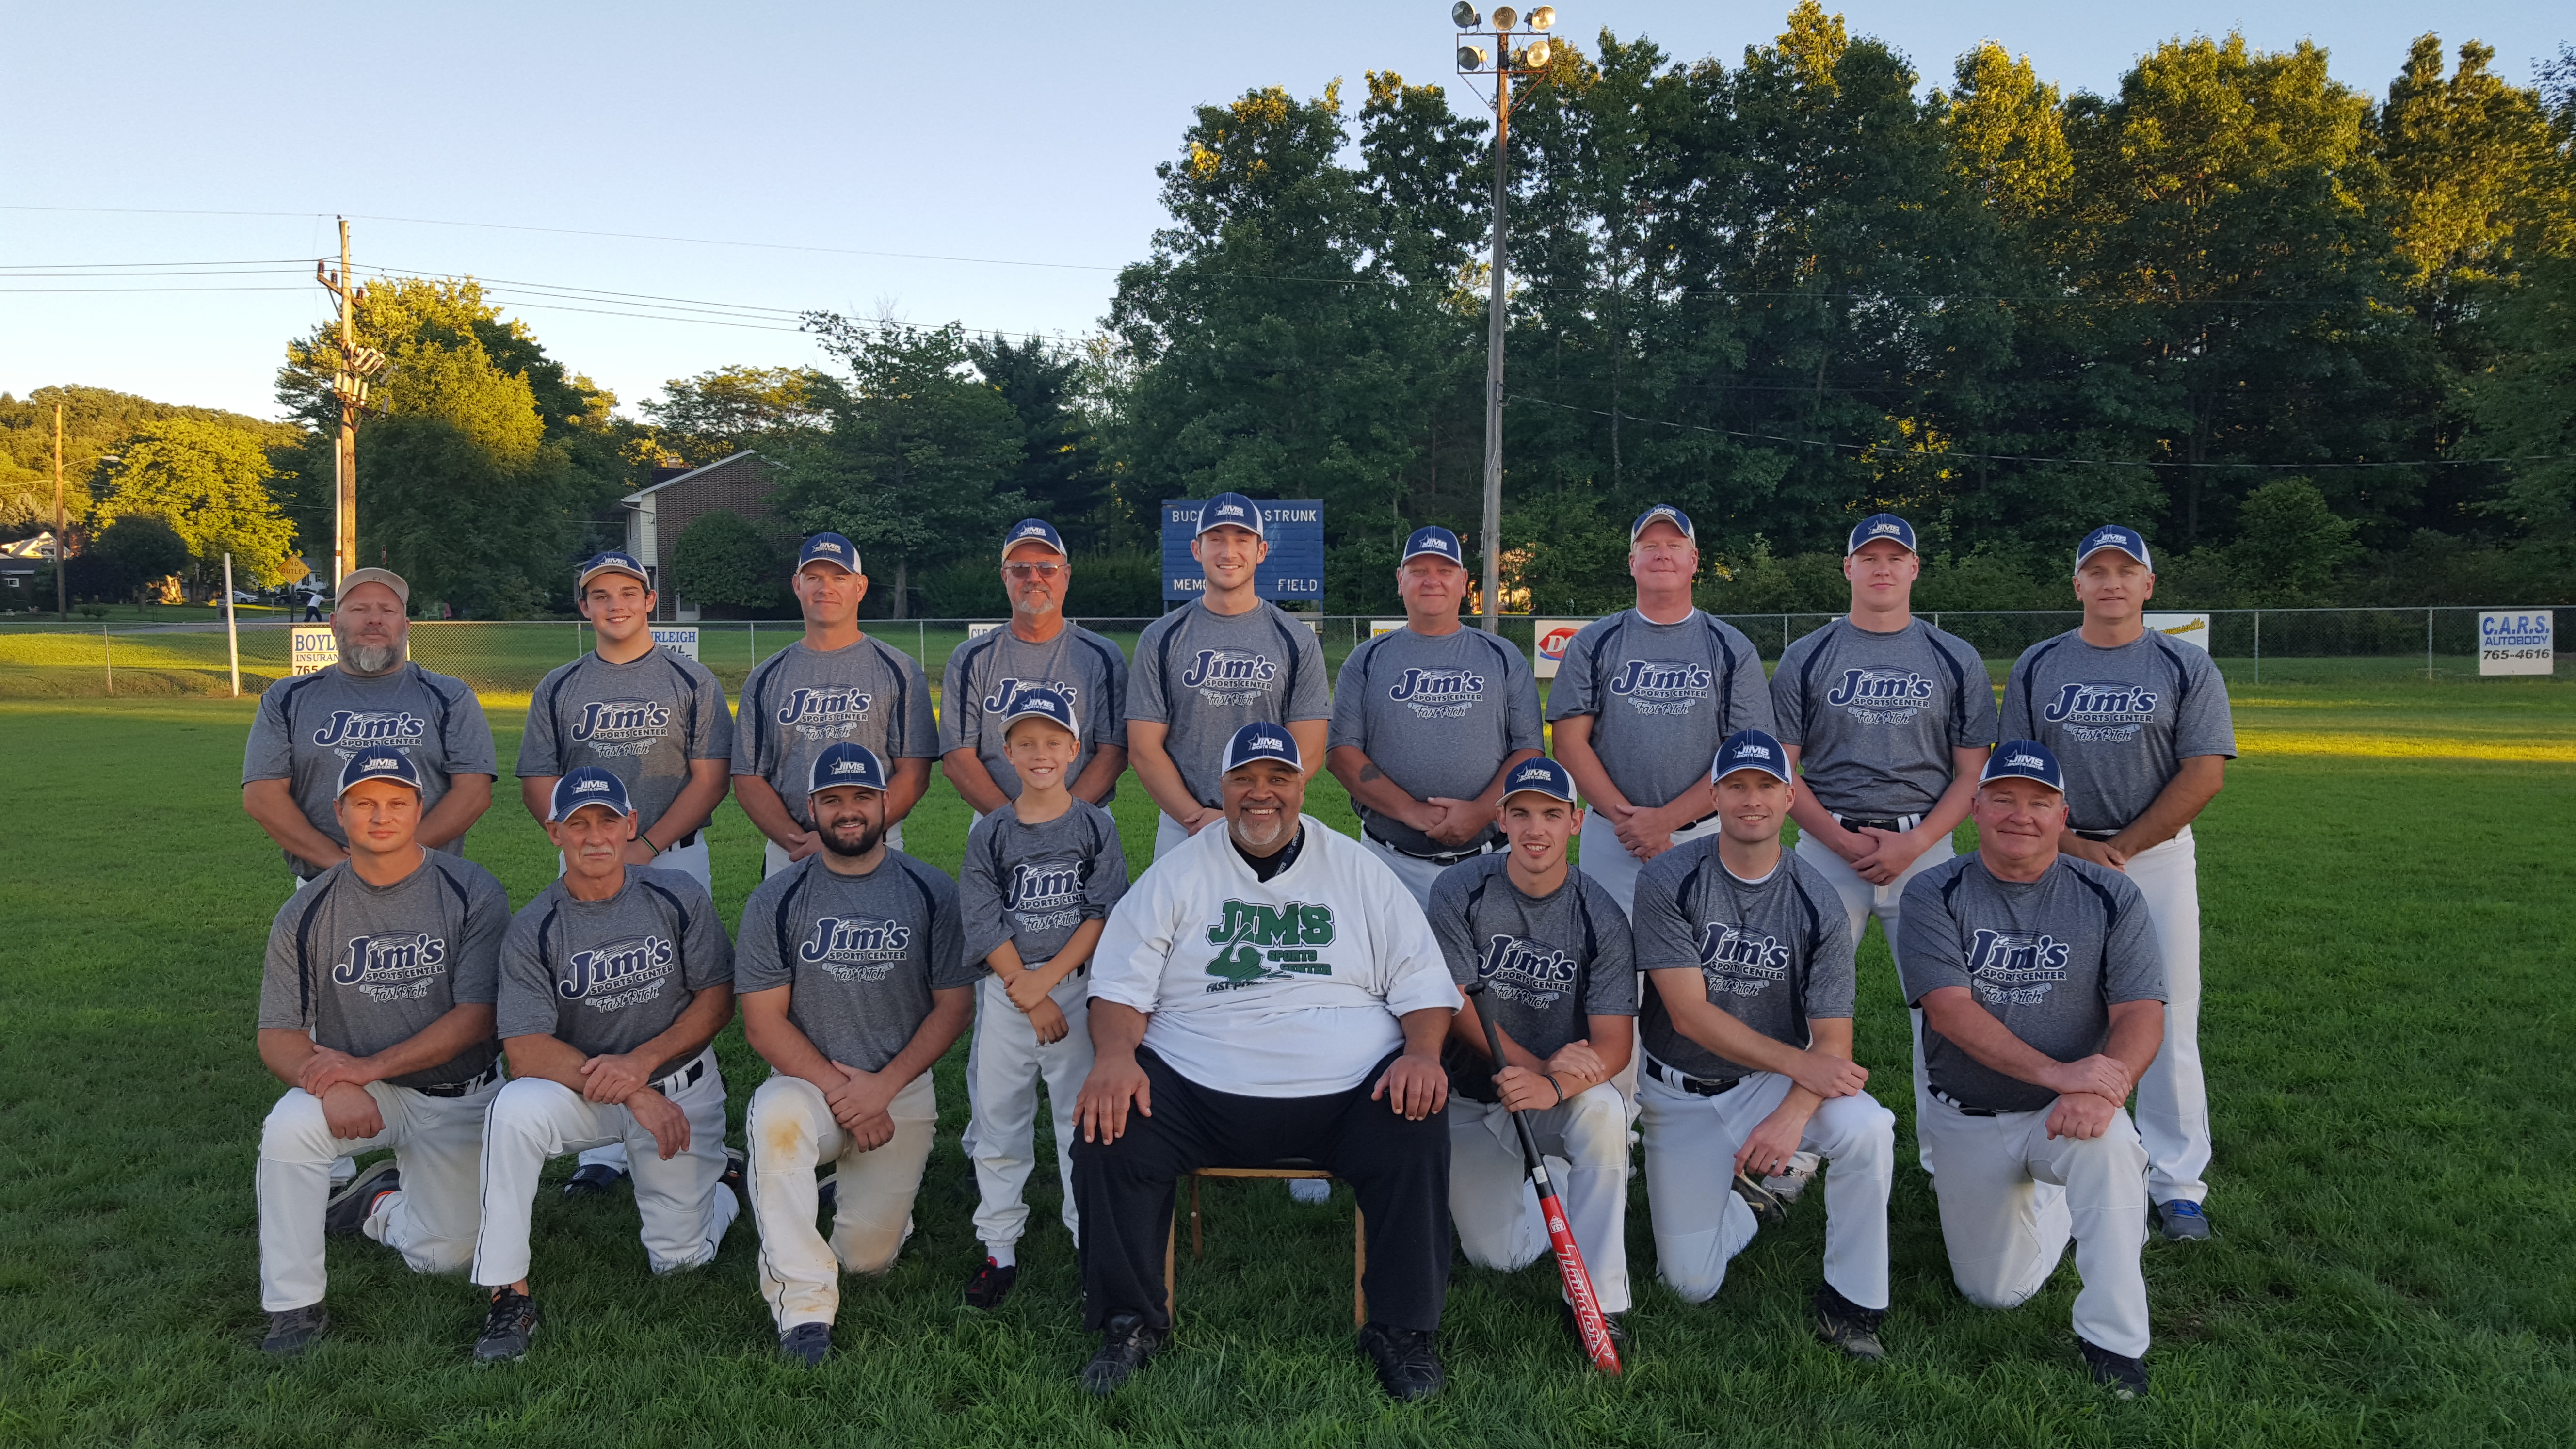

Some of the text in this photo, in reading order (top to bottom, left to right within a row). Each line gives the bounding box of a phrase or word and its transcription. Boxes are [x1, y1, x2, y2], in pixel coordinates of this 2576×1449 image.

[1173, 510, 1316, 522] BUC STRUNK
[1873, 524, 1900, 532] JIMS
[1422, 538, 1447, 547] JIMS
[1278, 579, 1318, 592] FIELD
[2483, 615, 2550, 635] C.A.R.S.
[295, 634, 338, 651] BOYL
[2485, 635, 2548, 646] AUTOBODY
[2483, 649, 2550, 660] 765-4616
[1182, 650, 1276, 687] Jim's
[1389, 668, 1484, 701] Jim's
[1610, 660, 1711, 695] Jim's
[1206, 679, 1272, 691] SPORTS CENTER
[1828, 669, 1933, 706] Jim's
[1208, 691, 1253, 706] Fast Pitch
[1672, 690, 1707, 698] CENTER
[777, 688, 871, 725] Jim's
[1024, 698, 1054, 708] JIMS
[1636, 701, 1688, 715] Fast Pitch
[1853, 698, 1930, 708] SPORTS CENTER
[2044, 683, 2157, 722] Jim's
[835, 713, 868, 721] CENTER
[1416, 705, 1465, 718] Fast Pitch
[1856, 710, 1909, 724] Fast Pitch
[2069, 713, 2154, 723] SPORTS CENTER
[313, 710, 424, 746] Jim's
[571, 701, 670, 741] Jim's
[594, 731, 630, 739] SPORTS
[804, 727, 825, 740] Fast
[2072, 726, 2132, 741] Fast Pitch
[340, 738, 422, 747] SPORTS CENTER
[1252, 737, 1283, 748] JIMS
[596, 743, 649, 758] Fast Pitch
[1738, 745, 1769, 756] JIMS
[365, 759, 397, 767] JIMS
[835, 762, 864, 771] JIMS
[2009, 755, 2044, 766] JIMS
[1521, 769, 1551, 777] JIMS
[576, 780, 608, 789] JIMS
[1019, 898, 1060, 910] SPORTS
[1023, 911, 1080, 932] Fast Pitch
[1205, 898, 1336, 948] JIMS
[800, 917, 910, 962] Jim's
[1701, 922, 1789, 970] Jim's
[828, 951, 907, 961] SPORTS CENTER
[1267, 949, 1318, 962] SPORTS
[1478, 934, 1577, 982] Jim's
[1964, 929, 2069, 974] Jim's
[333, 933, 445, 985] Jim's
[404, 964, 446, 978] CENTER
[559, 935, 672, 999] Jim's
[831, 964, 885, 981] Fast Pitch
[1279, 963, 1332, 976] CENTER
[1741, 966, 1784, 980] CENTER
[590, 964, 675, 995] SPORTS CENTER
[2021, 970, 2067, 980] CENTER
[1206, 981, 1232, 993] FAST
[1496, 971, 1571, 994] SPORTS CENTER
[1708, 975, 1758, 996] Fast Pitch
[370, 985, 397, 1002] Fast
[596, 987, 659, 1013] Fast Pitch
[1495, 983, 1549, 1009] Fast Pitch
[1981, 985, 2043, 1005] Fast Pitch
[1551, 1222, 1564, 1232] ASA
